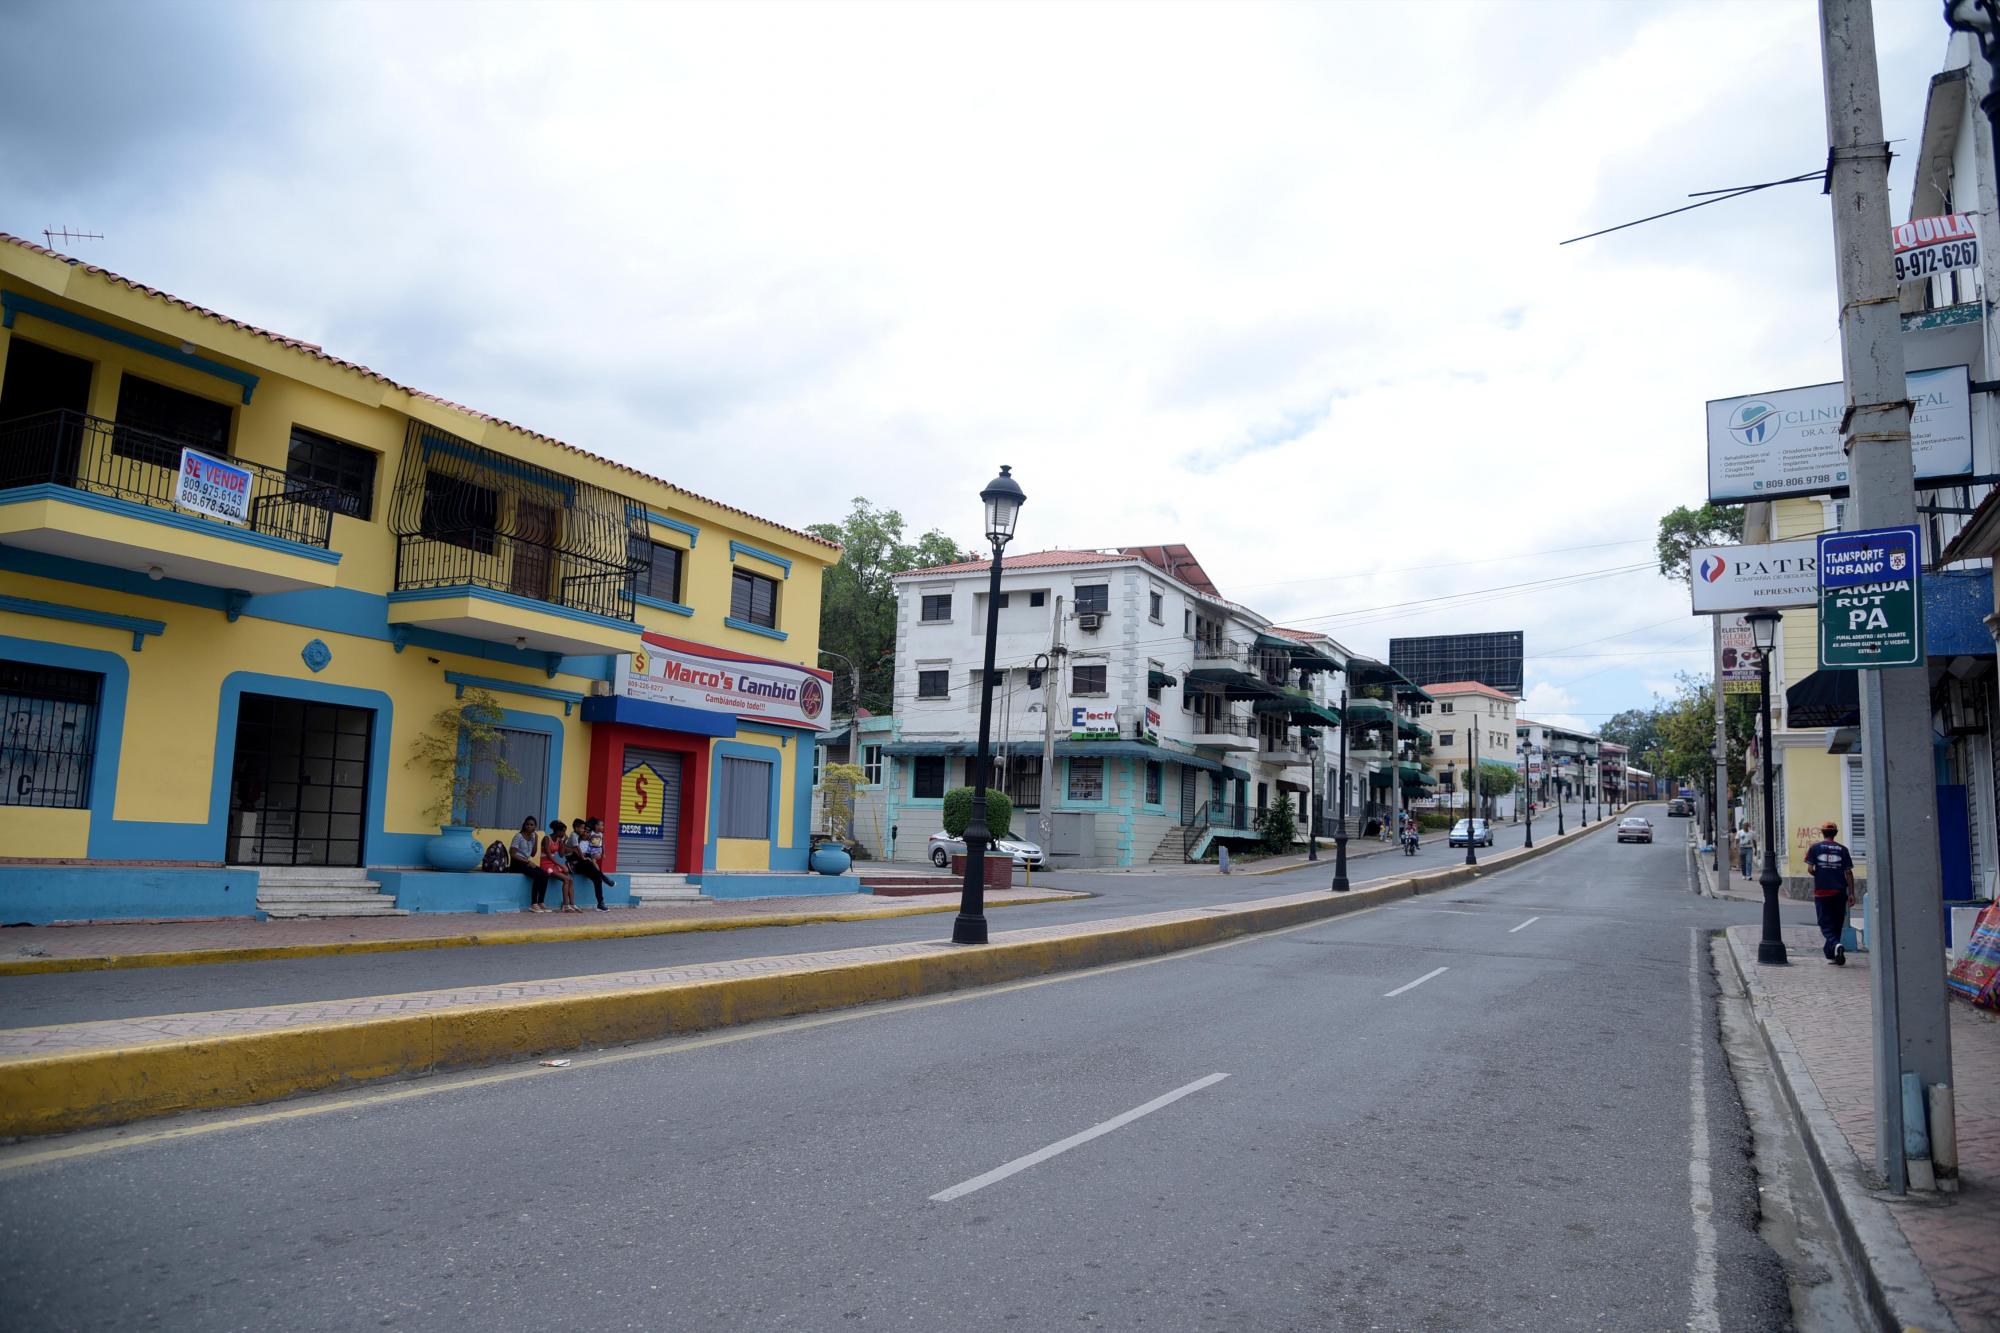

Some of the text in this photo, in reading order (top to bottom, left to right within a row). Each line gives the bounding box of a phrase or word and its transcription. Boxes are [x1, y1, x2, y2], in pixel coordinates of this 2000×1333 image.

[1894, 241, 1977, 281] 9-972-6267
[185, 457, 247, 494] SE VENDE
[1765, 474, 1830, 489] 809.806.9798
[181, 490, 241, 519] 809.678.5250
[183, 477, 242, 506] 809.975.6143
[1826, 548, 1885, 564] TRANSPORTE
[1826, 562, 1884, 575] URBANO
[1849, 607, 1889, 630] PA
[663, 660, 797, 701] Marco's Cambio
[621, 825, 641, 834] DESDE
